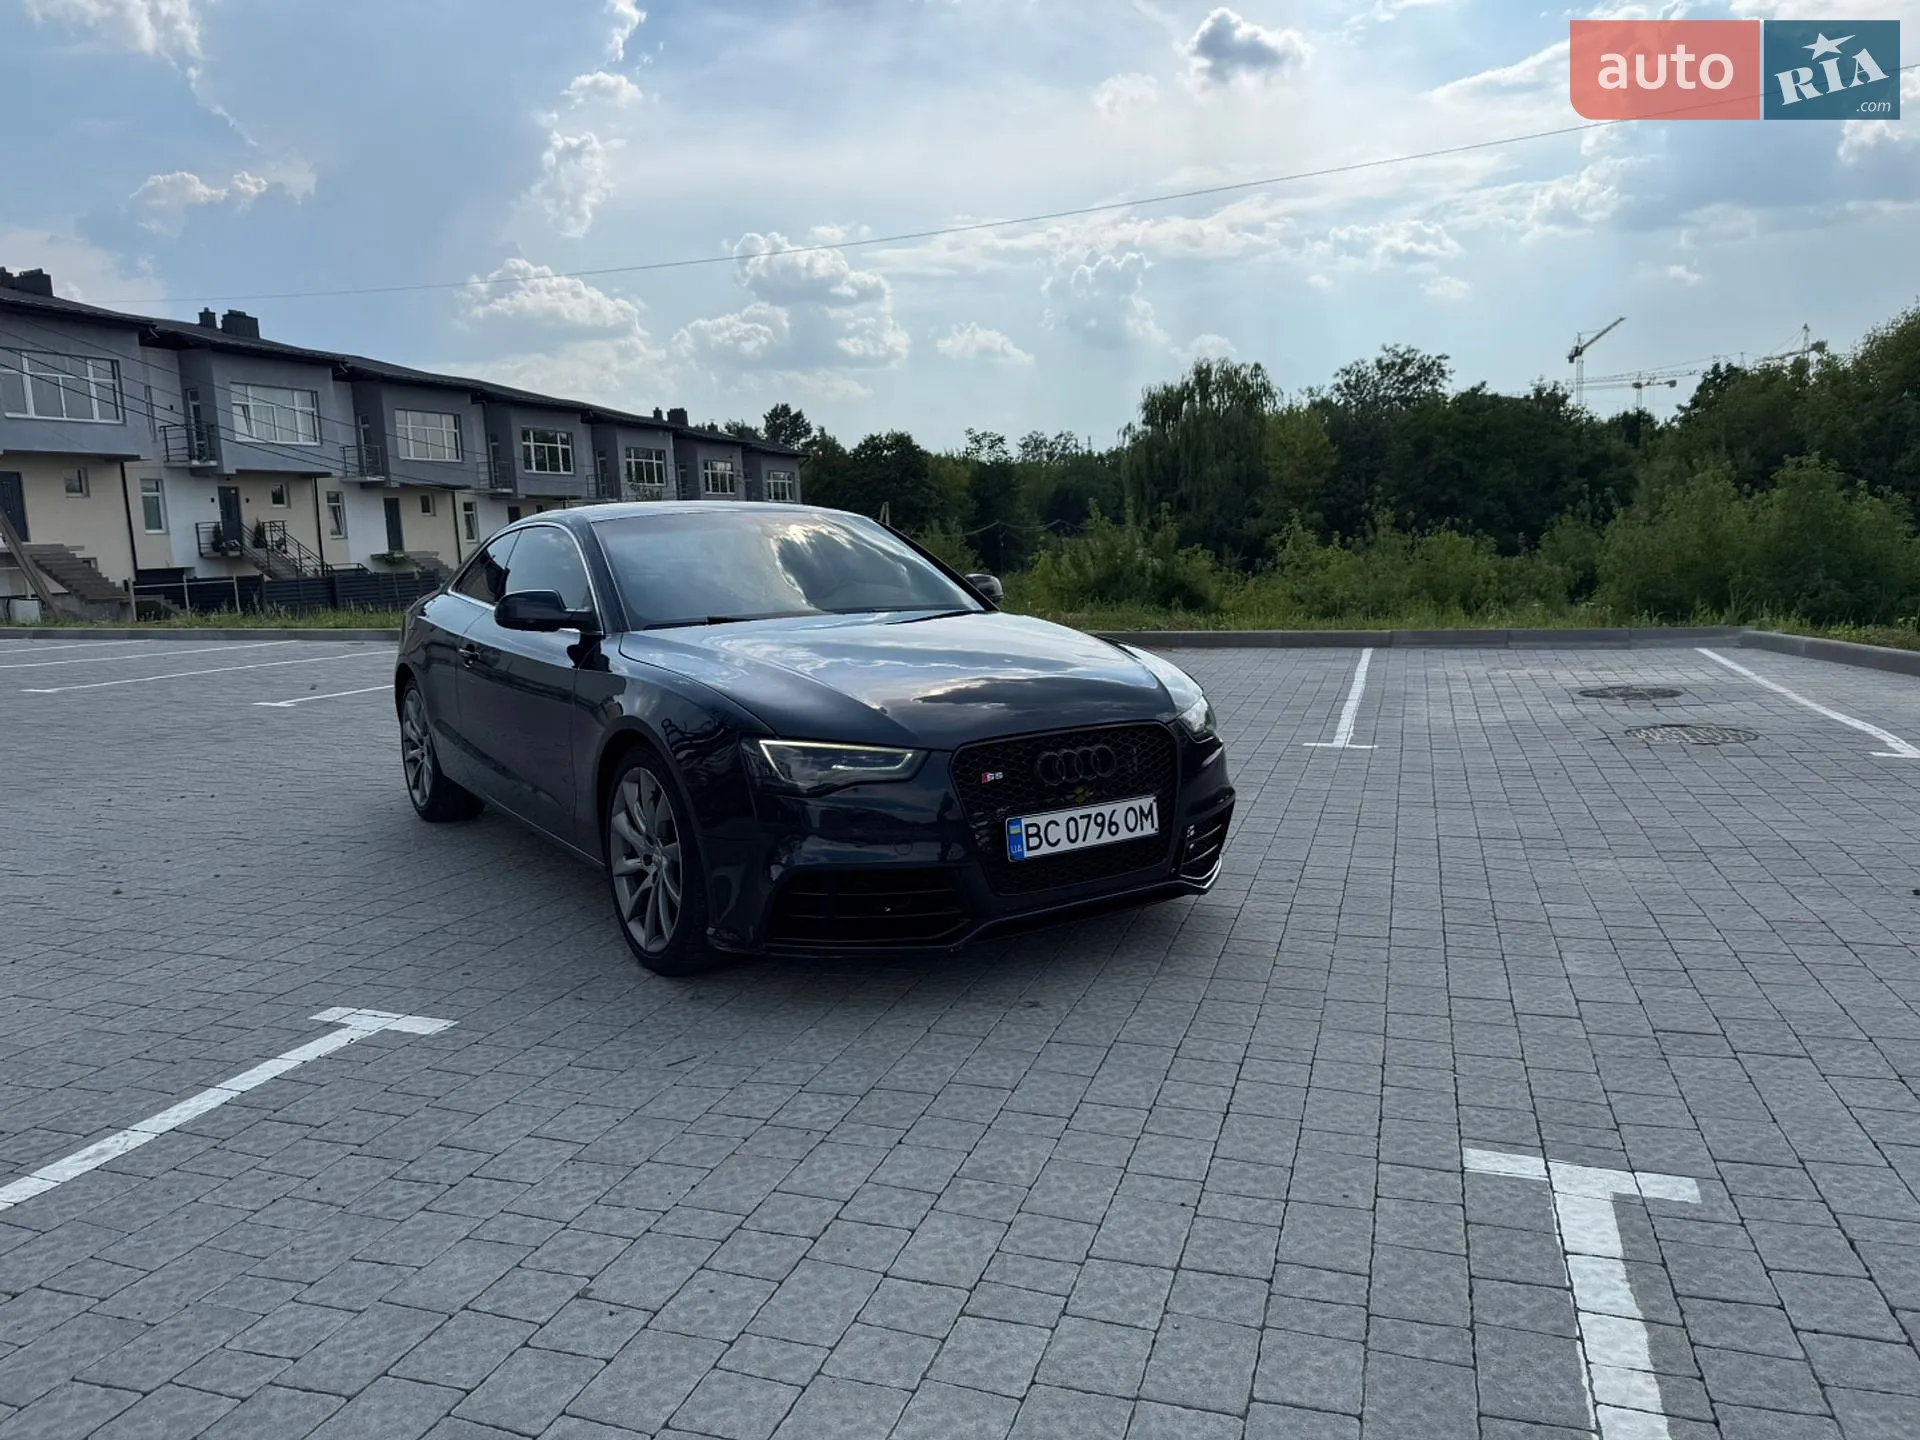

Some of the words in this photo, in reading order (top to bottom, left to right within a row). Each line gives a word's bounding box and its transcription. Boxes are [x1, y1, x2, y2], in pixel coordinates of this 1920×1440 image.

[1024, 820, 1061, 852] BC
[1066, 809, 1119, 844] 0796
[1124, 803, 1155, 833] OM
